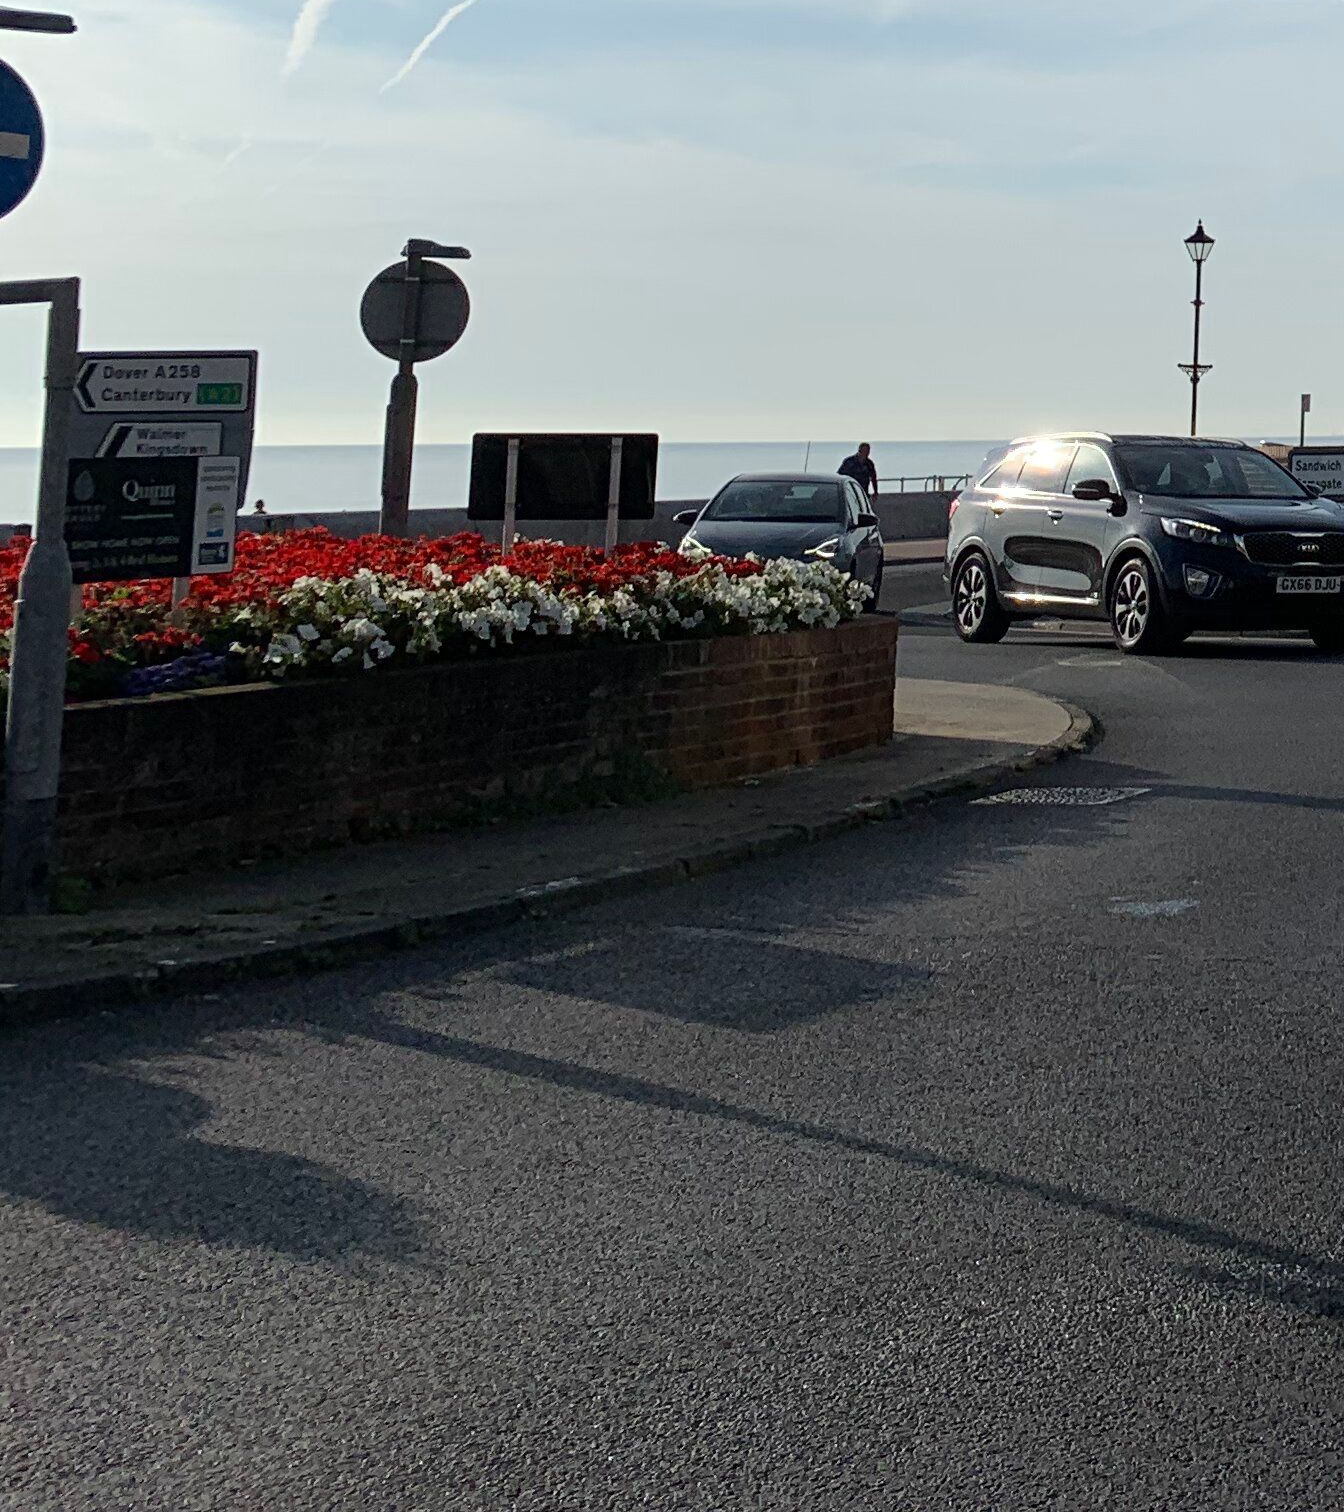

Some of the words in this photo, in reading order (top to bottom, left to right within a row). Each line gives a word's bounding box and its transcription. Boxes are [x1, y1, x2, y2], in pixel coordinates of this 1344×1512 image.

[103, 365, 148, 379] Dover
[155, 365, 201, 379] A258
[101, 389, 192, 405] Canterbury
[1295, 460, 1341, 471] Sandwich
[1281, 578, 1312, 591] GX66
[1314, 578, 1337, 591] DJU
